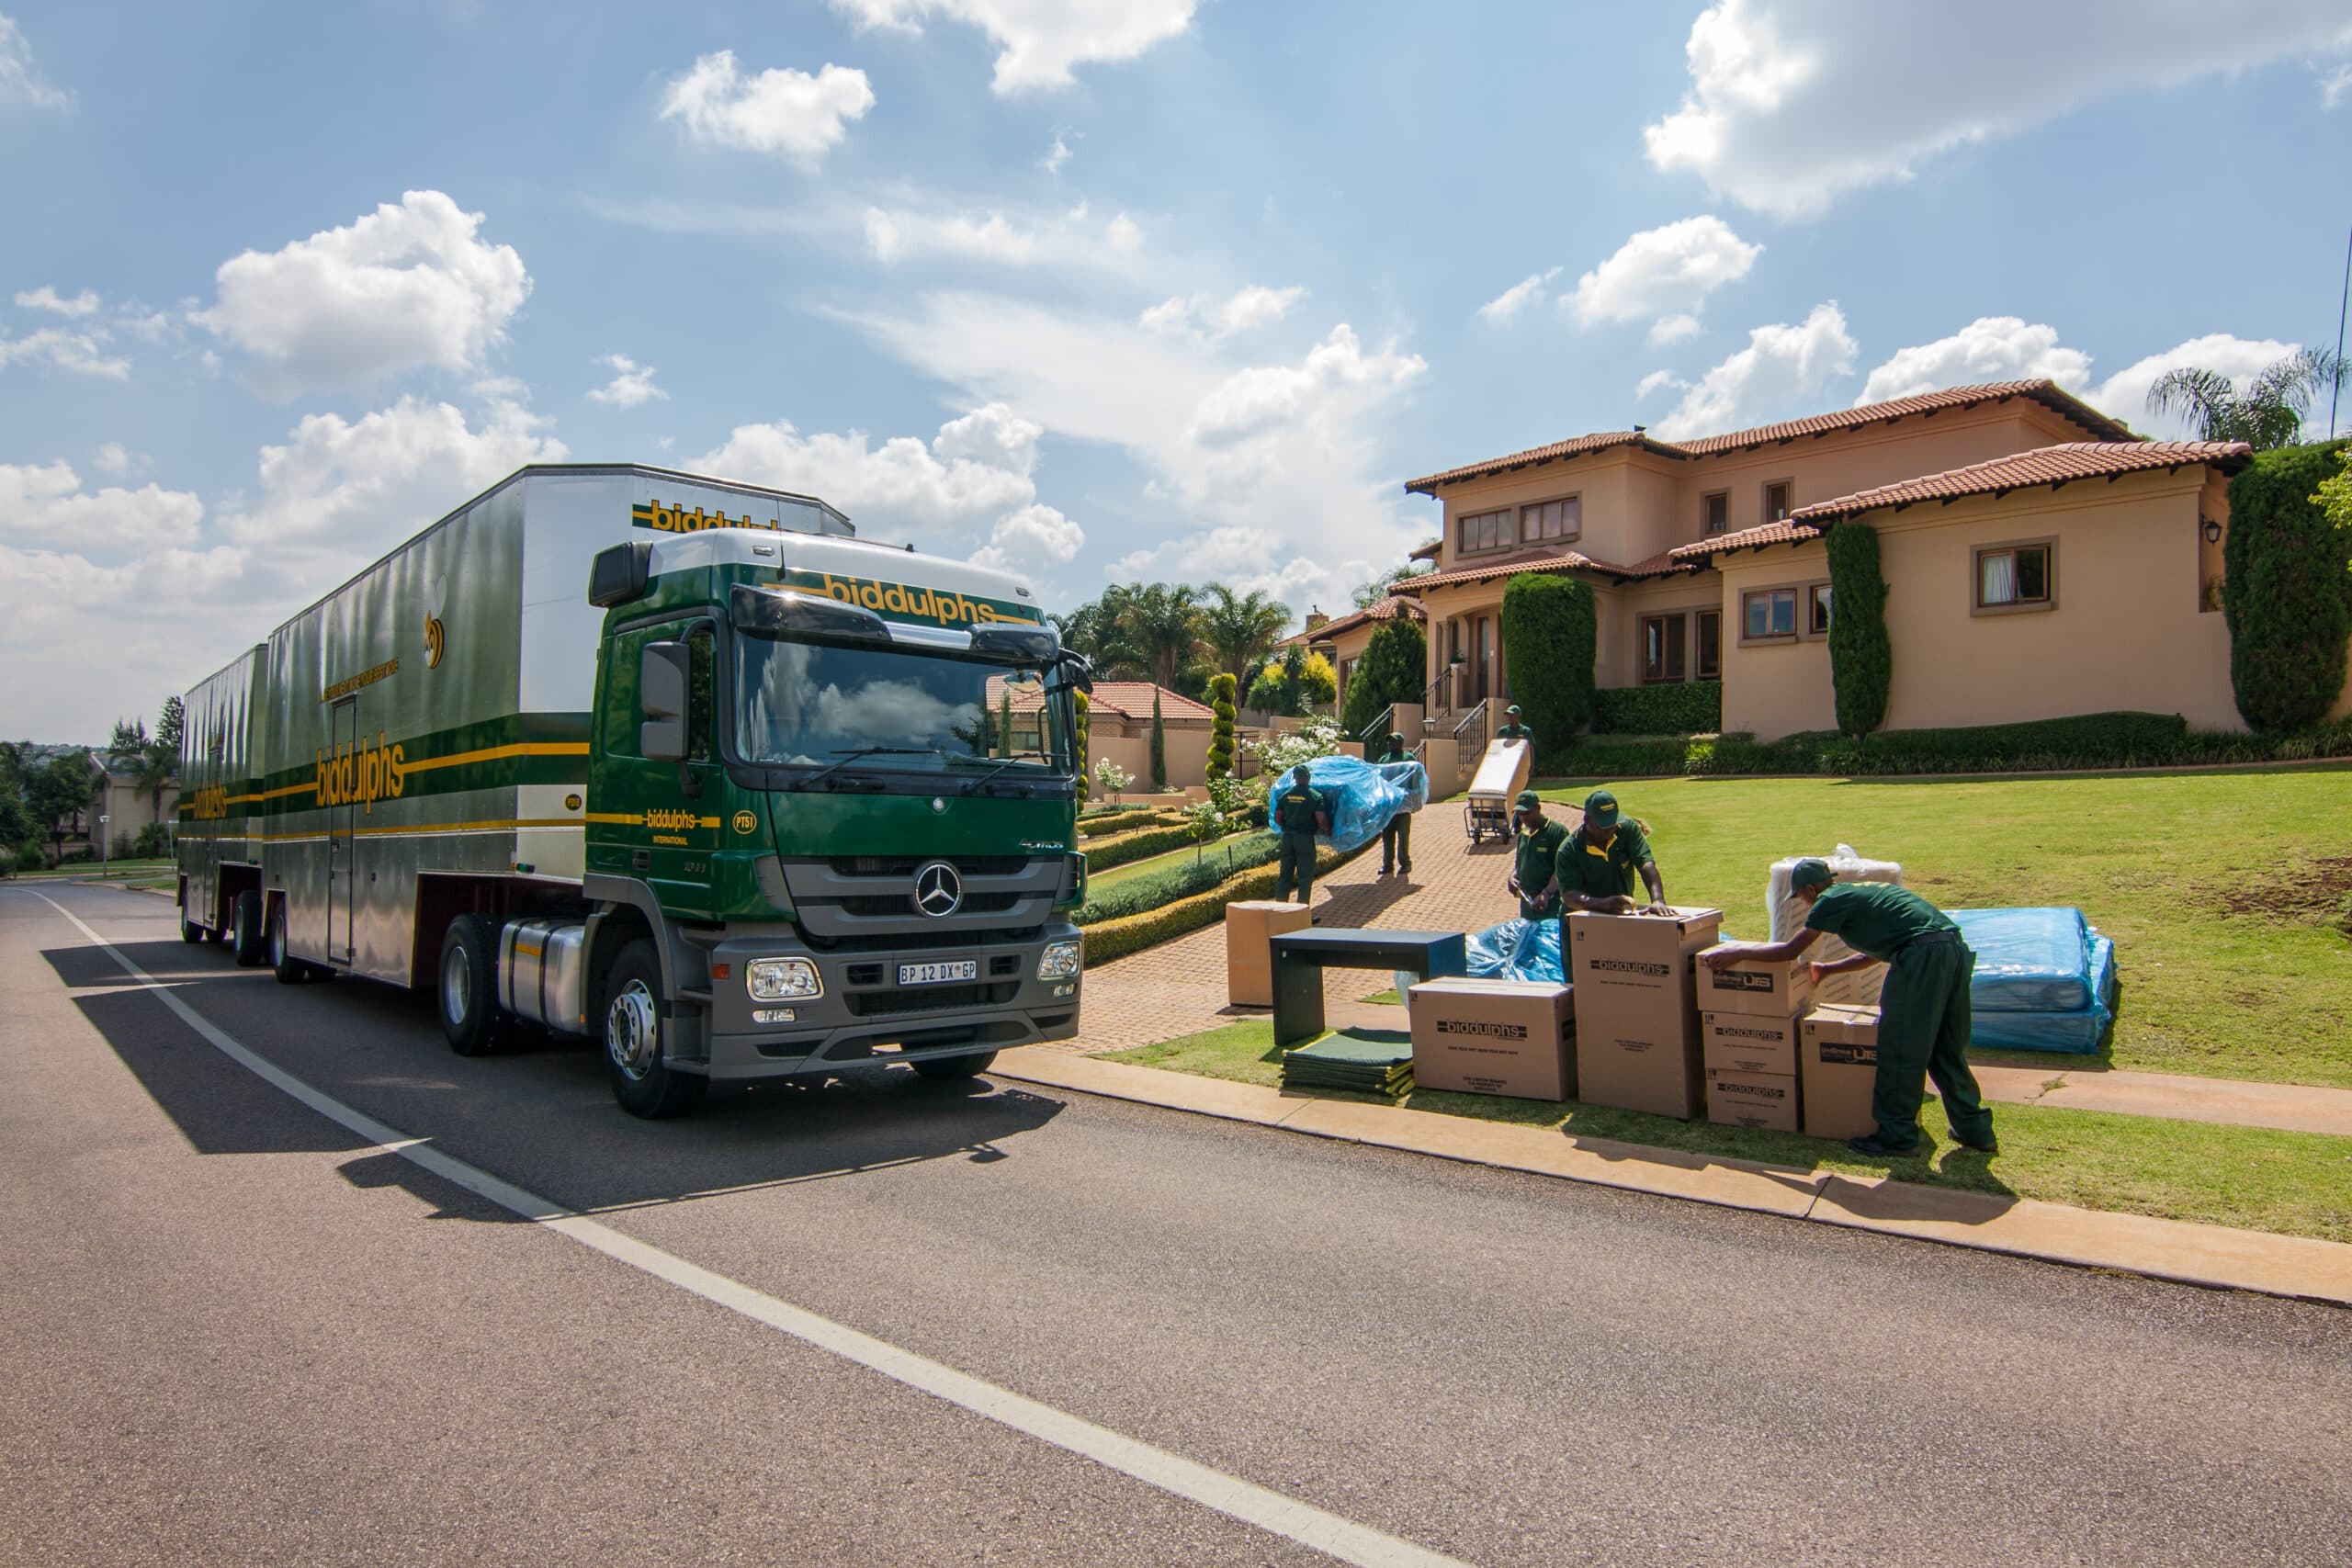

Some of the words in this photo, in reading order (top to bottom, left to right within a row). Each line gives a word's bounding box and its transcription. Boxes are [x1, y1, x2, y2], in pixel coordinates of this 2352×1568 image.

[823, 573, 995, 626] biddulphs
[317, 730, 404, 816] biddulphs
[647, 808, 695, 832] biddulphs
[736, 815, 753, 829] PT51
[653, 835, 688, 846] INTERNATIONAL
[901, 967, 915, 982] BP
[922, 965, 934, 980] 12
[940, 964, 954, 979] DX
[963, 963, 975, 977] GP
[1600, 958, 1662, 975] biddulphs
[1447, 1018, 1520, 1038] biddulphs
